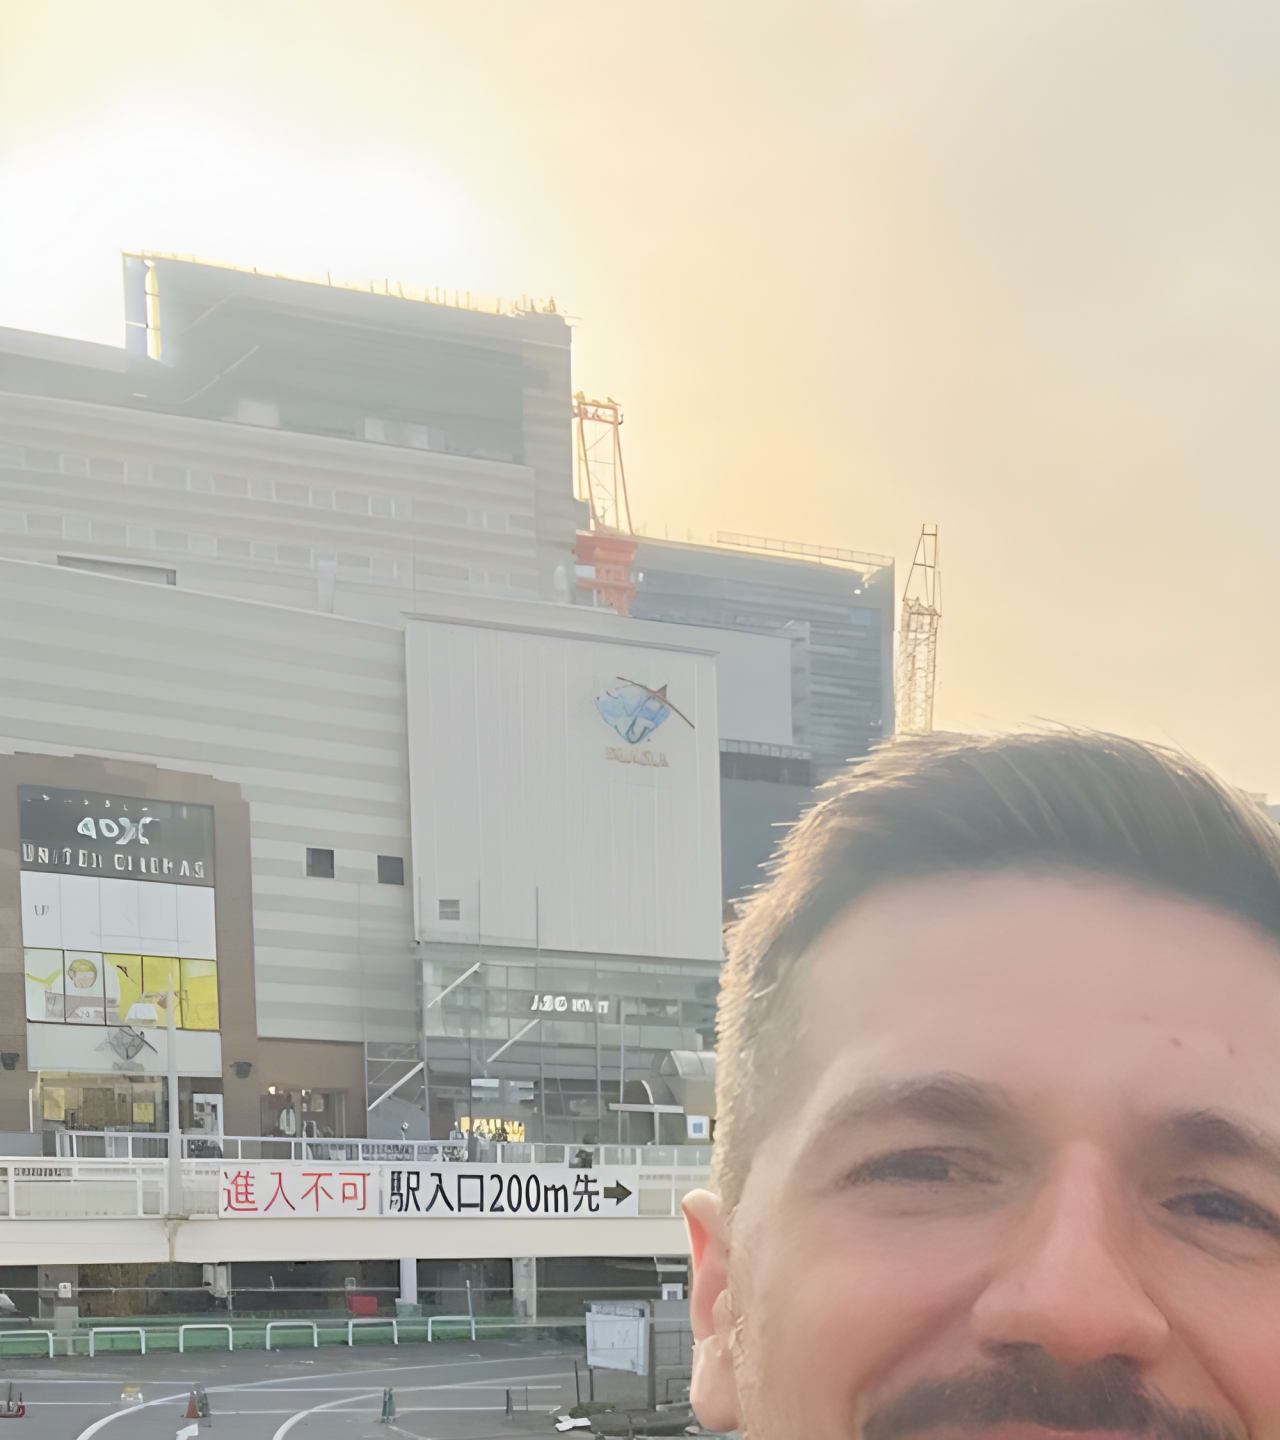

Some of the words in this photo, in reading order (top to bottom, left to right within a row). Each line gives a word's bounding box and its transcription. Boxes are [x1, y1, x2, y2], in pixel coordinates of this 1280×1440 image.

[222, 1170, 371, 1213] 進入不可
[389, 1170, 600, 1213] 駅入口200m先
